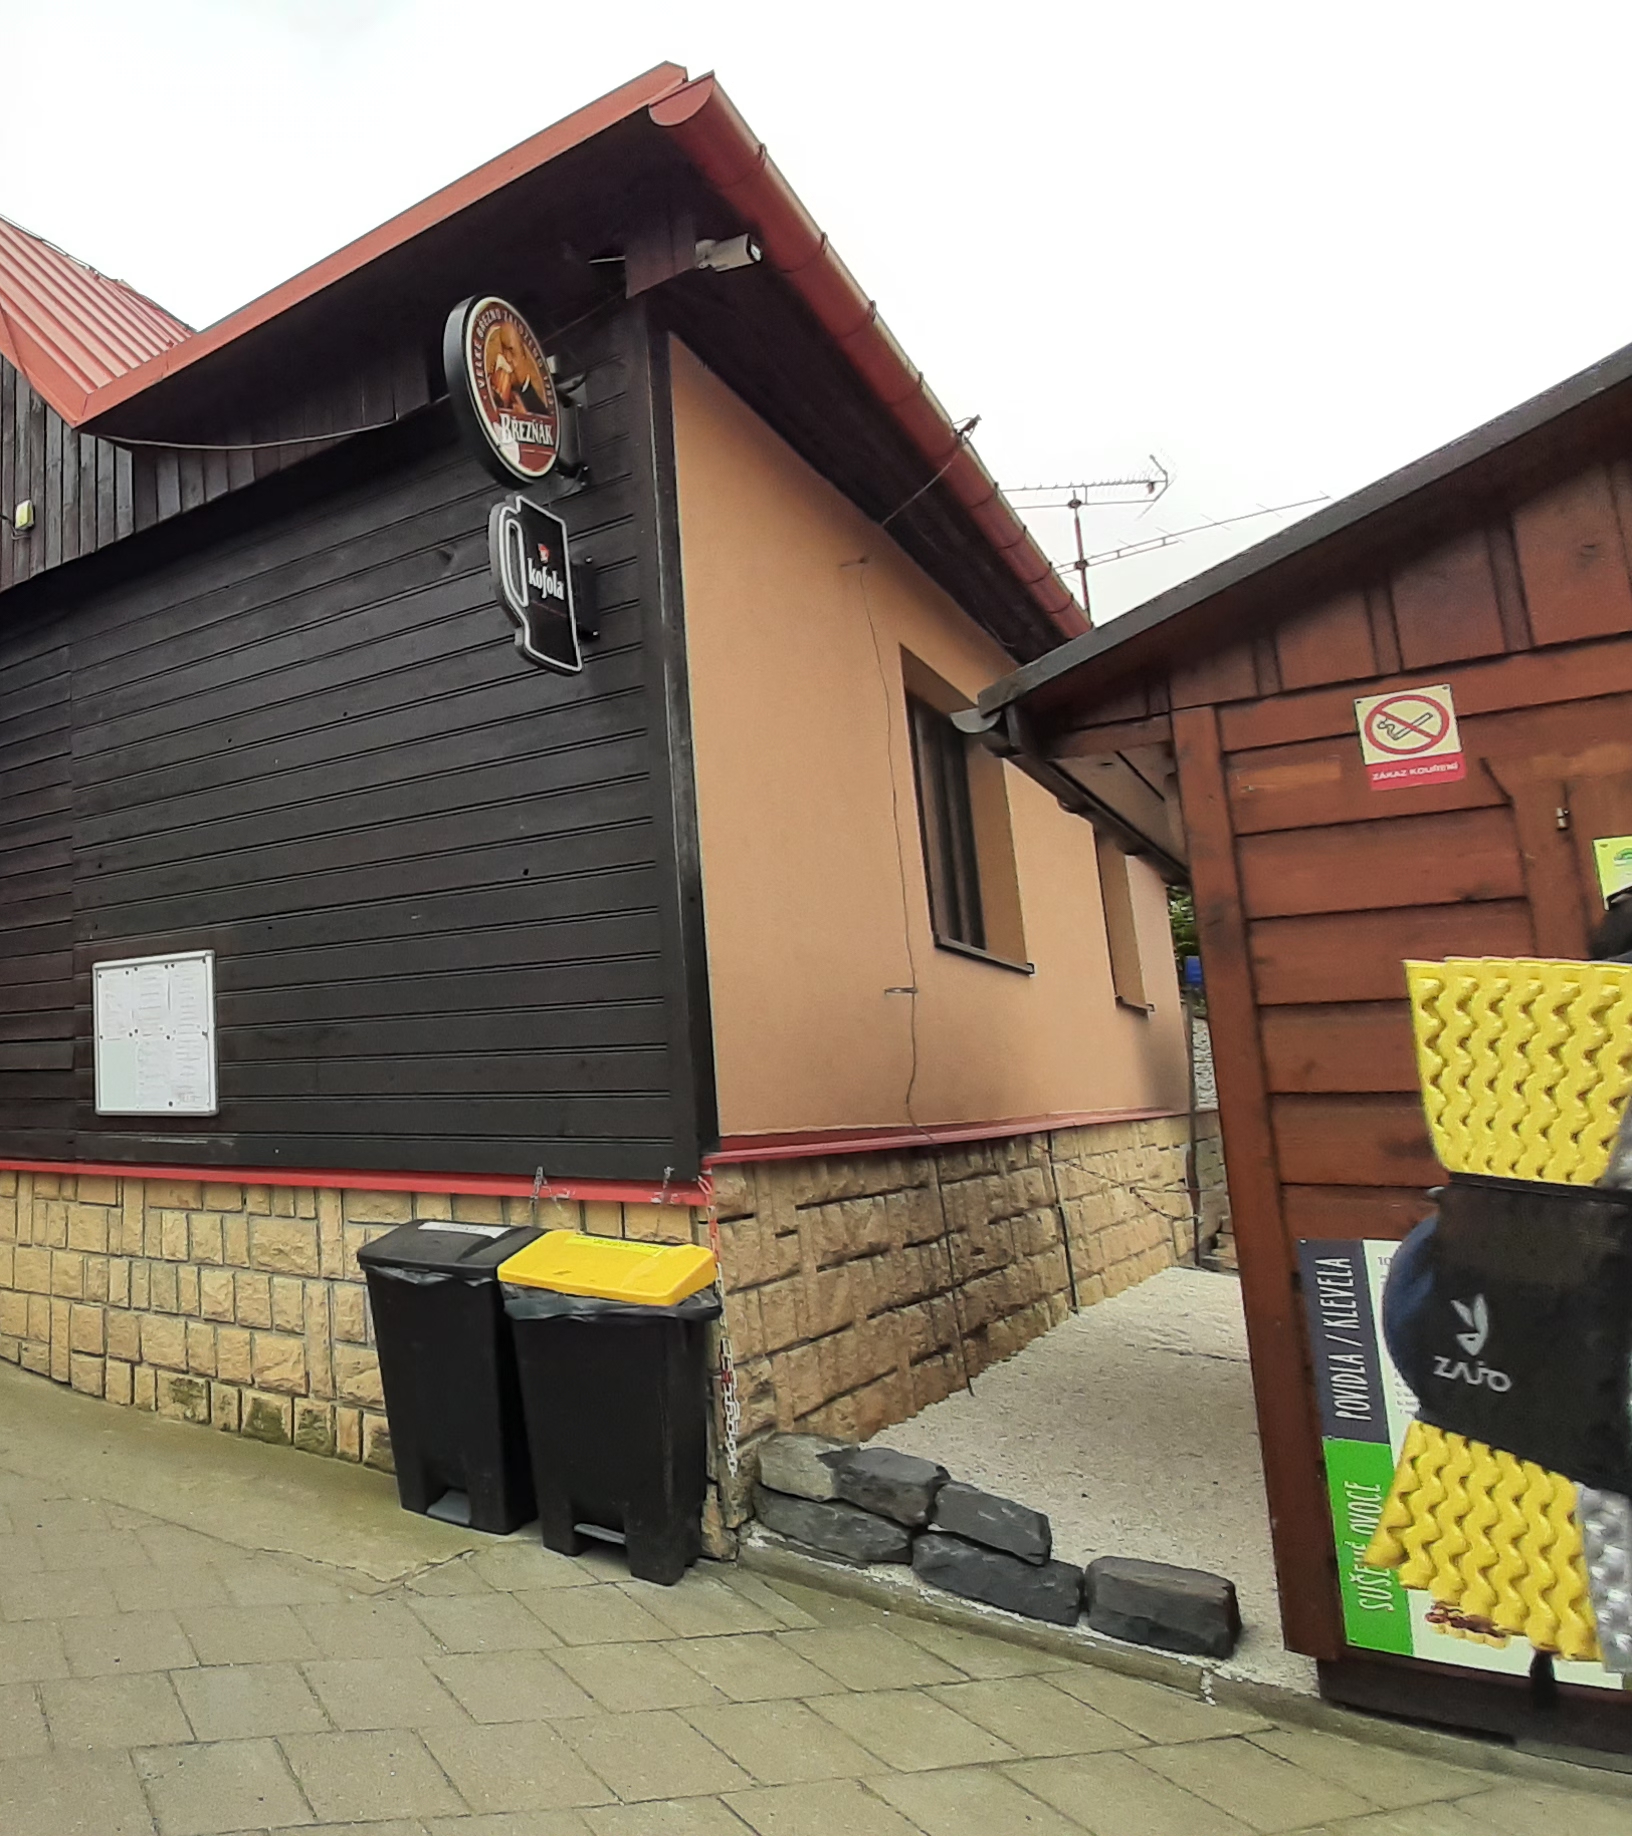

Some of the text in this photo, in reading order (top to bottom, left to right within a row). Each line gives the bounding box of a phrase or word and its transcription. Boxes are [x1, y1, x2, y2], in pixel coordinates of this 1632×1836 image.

[499, 413, 554, 446] BŘEZŇÁK
[526, 557, 565, 601] kofola
[1372, 768, 1408, 781] ZÁKAZ
[1315, 1257, 1360, 1330] KLEVELA
[1327, 1353, 1372, 1421] POVIDLA
[1343, 1480, 1383, 1536] OVOCE
